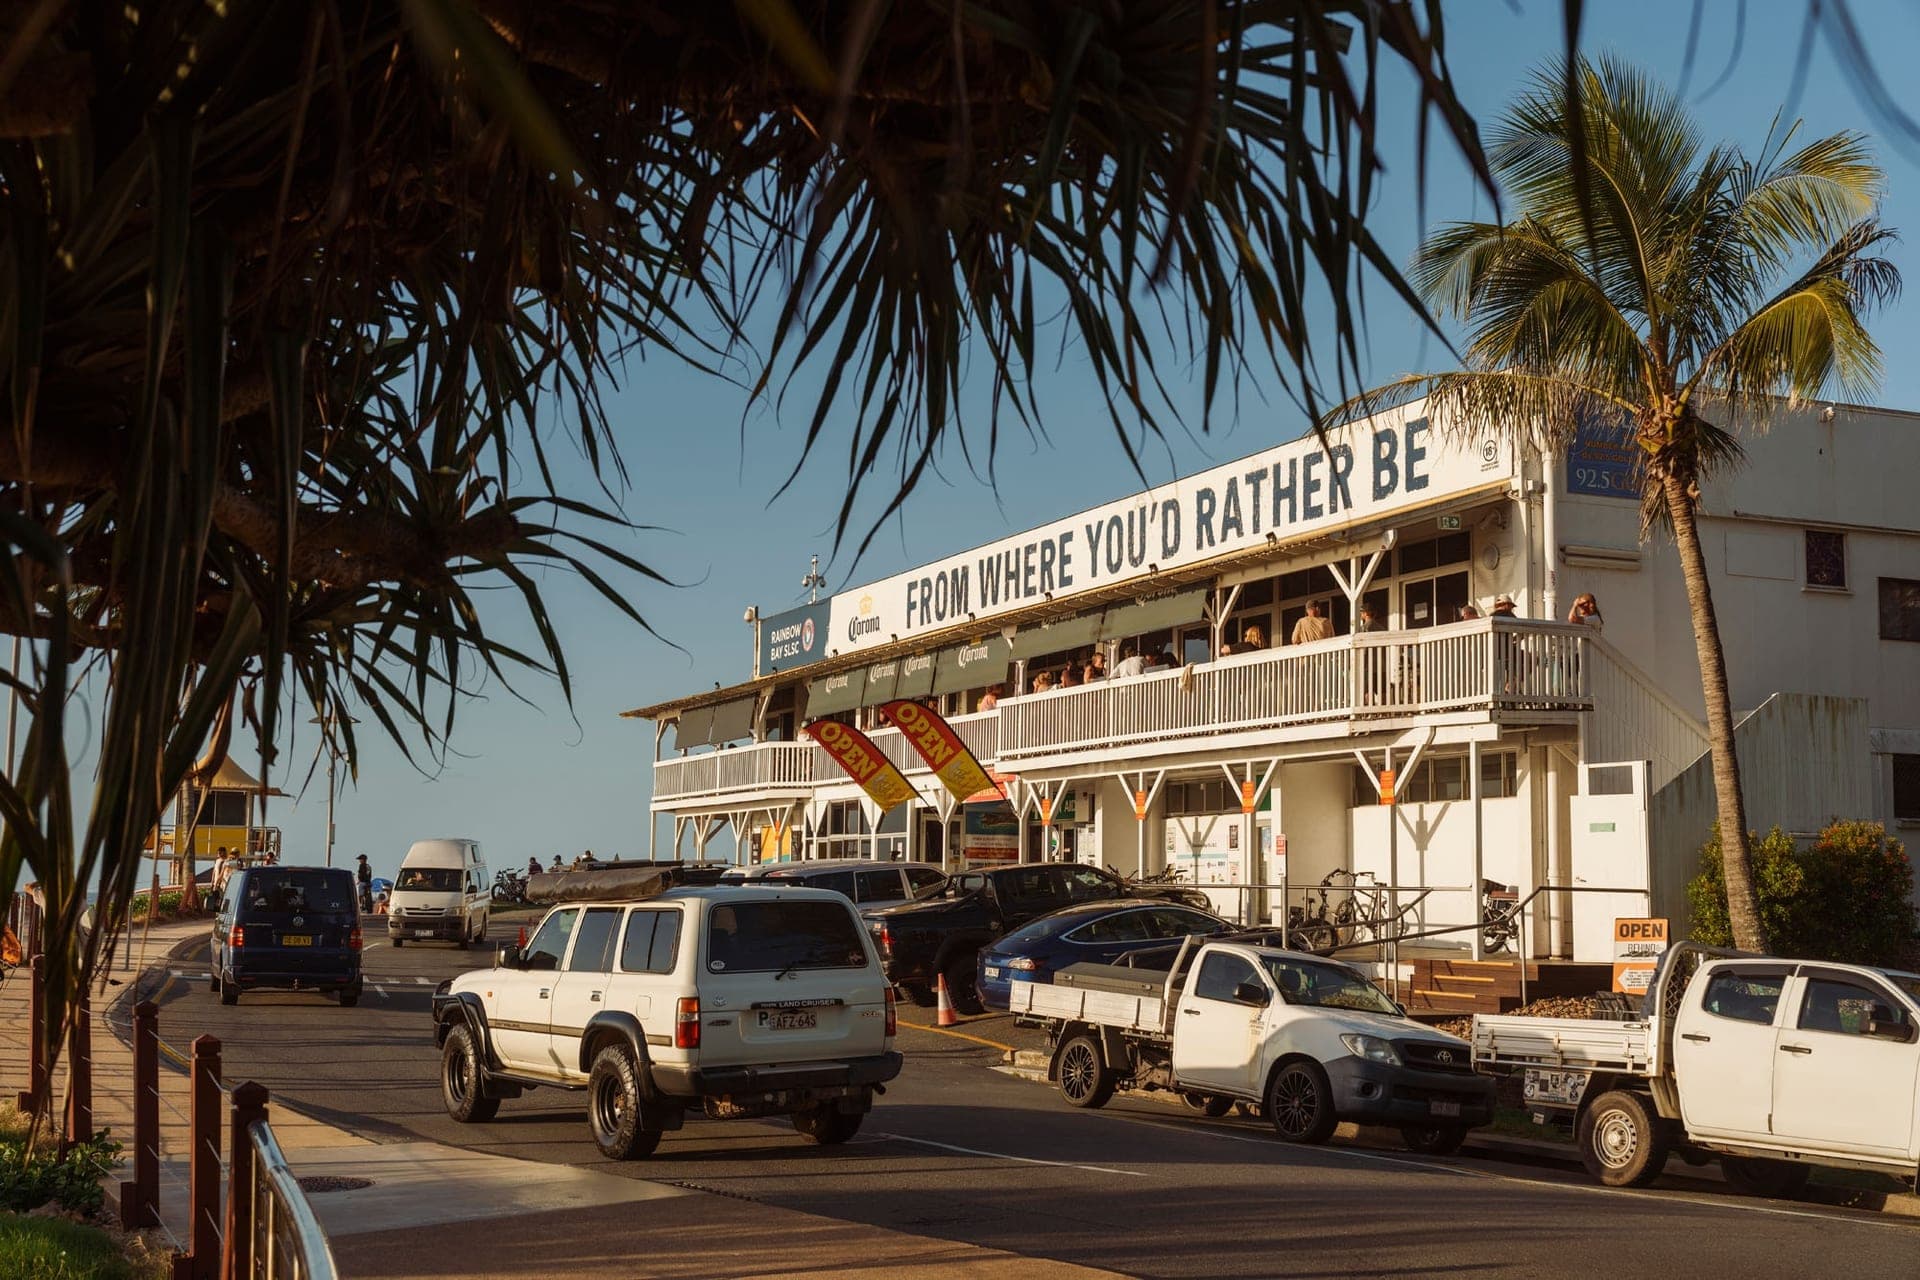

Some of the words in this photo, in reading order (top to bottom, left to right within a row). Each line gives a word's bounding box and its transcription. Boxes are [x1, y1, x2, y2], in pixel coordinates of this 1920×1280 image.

[906, 564, 969, 629] FROM
[979, 530, 1073, 609] WHERE
[1085, 498, 1181, 578] YOU'D
[1196, 443, 1353, 551] RATHER
[1372, 416, 1429, 502] BE
[771, 623, 802, 644] RAINBOW
[848, 615, 880, 643] Corona
[770, 646, 784, 661] BAY
[783, 641, 800, 657] SLSC
[957, 645, 988, 669] Corona
[869, 663, 896, 683] Corona
[904, 655, 931, 677] Corona
[825, 674, 848, 694] Corona
[896, 703, 955, 765] OPEN
[820, 722, 878, 778] OPEN
[1619, 923, 1663, 938] OPEN
[779, 1000, 800, 1009] LAND
[801, 998, 835, 1009] CRUISER
[759, 1011, 769, 1026] P
